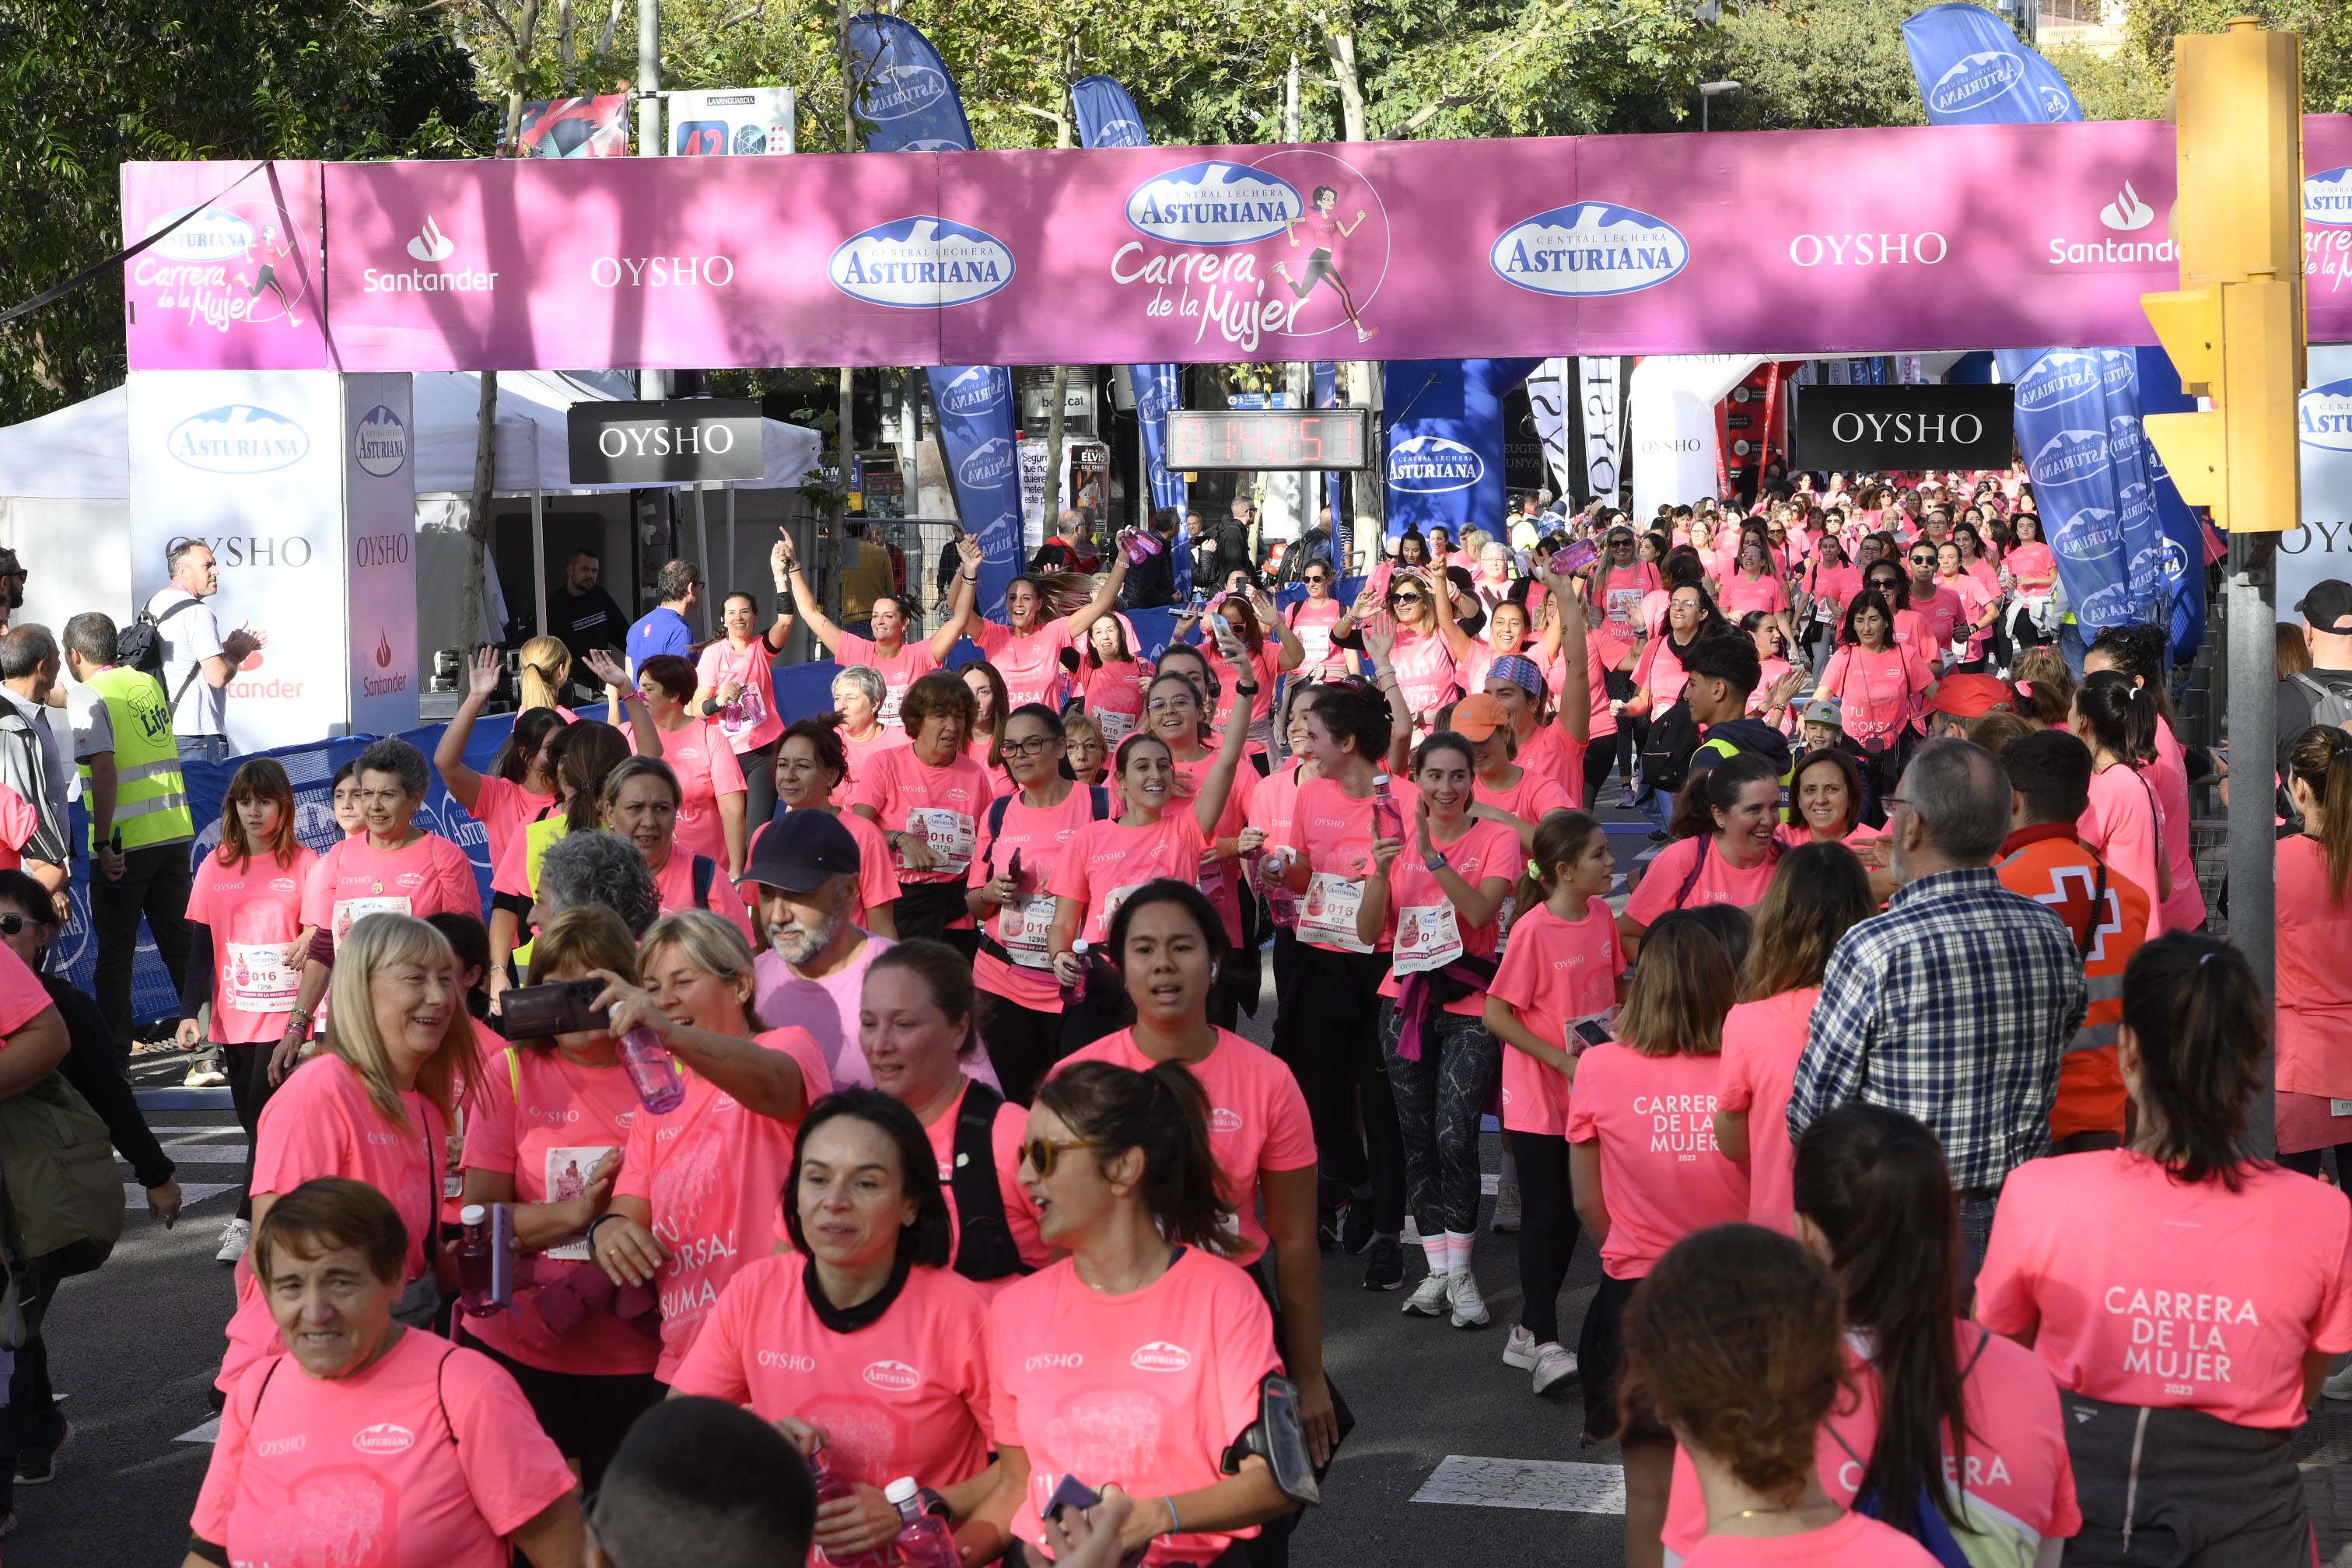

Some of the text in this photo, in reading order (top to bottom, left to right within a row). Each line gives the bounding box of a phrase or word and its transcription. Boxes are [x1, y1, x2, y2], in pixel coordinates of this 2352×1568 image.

[715, 96, 754, 105] VANGUARDIA
[1228, 189, 1283, 198] LECHERA
[1139, 194, 1288, 223] ASTURIANA
[1536, 233, 1667, 245] CENTRAL LECHERA
[1789, 232, 1948, 266] OYSHO
[871, 247, 994, 257] CENTRAL LECHERA
[1506, 239, 1673, 272] ASTURIANA
[2049, 238, 2181, 264] Santand
[134, 257, 226, 287] Carrera
[591, 255, 734, 287] OYSHO
[842, 250, 1001, 284] ASTURIANA
[1111, 241, 1257, 285] Carrera
[363, 267, 499, 292] Santander
[157, 283, 261, 333] de la Mujer
[1146, 279, 1311, 352] de la Mujer
[1042, 396, 1084, 408] b.cat
[1832, 413, 1983, 444] OYSHO
[179, 431, 299, 457] ASTURIANA
[359, 432, 404, 460] ASTURIANA
[598, 424, 734, 457] OYSHO
[1178, 418, 1354, 461] 01:42:51
[1643, 438, 1701, 454] OYSHO
[1081, 452, 1104, 462] ELVIS
[1389, 459, 1477, 481] ASTURIANA
[356, 532, 408, 568] OYSHO
[228, 678, 305, 699] tander
[362, 674, 407, 698] Santander
[1009, 691, 1045, 702] ORSAL
[128, 689, 158, 718] Sport
[1850, 706, 1864, 717] TU
[141, 704, 170, 738] Life
[1103, 726, 1118, 734] 016
[1314, 817, 1345, 828] OYSHO
[930, 832, 954, 842] 016
[1001, 835, 1031, 845] OYSHO
[1092, 851, 1125, 863] OYSHO
[214, 881, 245, 892] OYSHO
[341, 876, 372, 884] OYSHO
[1704, 890, 1733, 901] OYSHO
[1327, 903, 1354, 915] 016
[1026, 922, 1051, 934] 016
[1331, 916, 1344, 925] 632
[1400, 962, 1421, 971] OYSHO
[1555, 954, 1585, 970] OYSHO
[251, 971, 277, 981] 016
[1633, 1094, 1718, 1115] CARRER
[1654, 1114, 1714, 1133] DE LA
[1650, 1133, 1720, 1153] MUJER
[669, 1229, 737, 1277] ORSAL
[662, 1277, 717, 1321] SUMA
[2105, 1286, 2259, 1326] CARRERA
[2132, 1318, 2227, 1352] DE LA
[758, 1350, 816, 1372] OYSHO
[1025, 1353, 1083, 1372] OYSHO
[2123, 1347, 2232, 1382] MUJER
[866, 1368, 916, 1384] ASTURIANA
[2165, 1383, 2193, 1396] 2023
[258, 1434, 306, 1457] OYSHO
[359, 1436, 409, 1446] ASTURIANA
[1839, 1454, 2012, 1493] CERA
